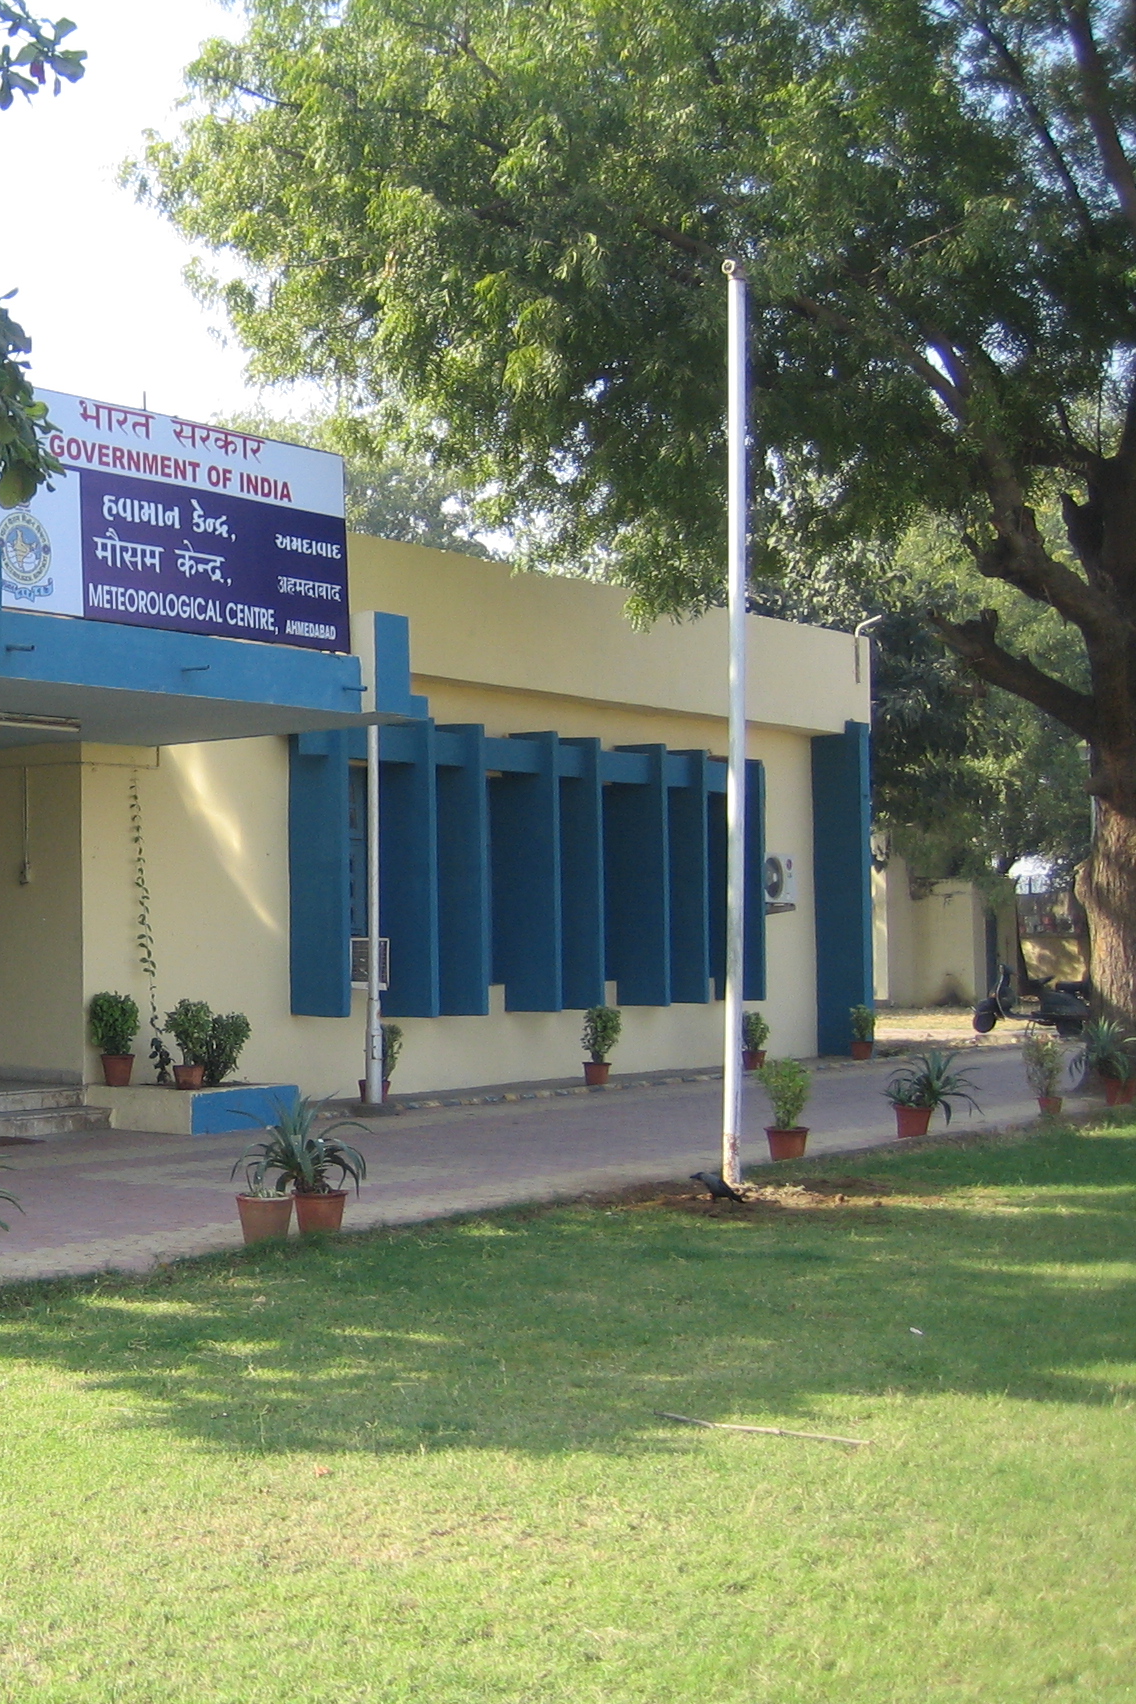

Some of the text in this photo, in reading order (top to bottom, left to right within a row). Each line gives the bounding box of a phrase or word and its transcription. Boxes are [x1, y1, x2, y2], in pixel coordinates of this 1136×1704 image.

[79, 399, 266, 463] भारत सरकार
[49, 434, 293, 503] GOVERNMENT OF INDIA
[102, 494, 181, 530] હવામાન
[92, 527, 164, 574] मौसम
[174, 539, 234, 587] केन्द्र,
[274, 533, 342, 560] અમદાવાદ
[89, 582, 223, 624] METEOROLOGICAL
[225, 602, 280, 635] CENTRE,
[285, 619, 337, 641] AHMEDABAD
